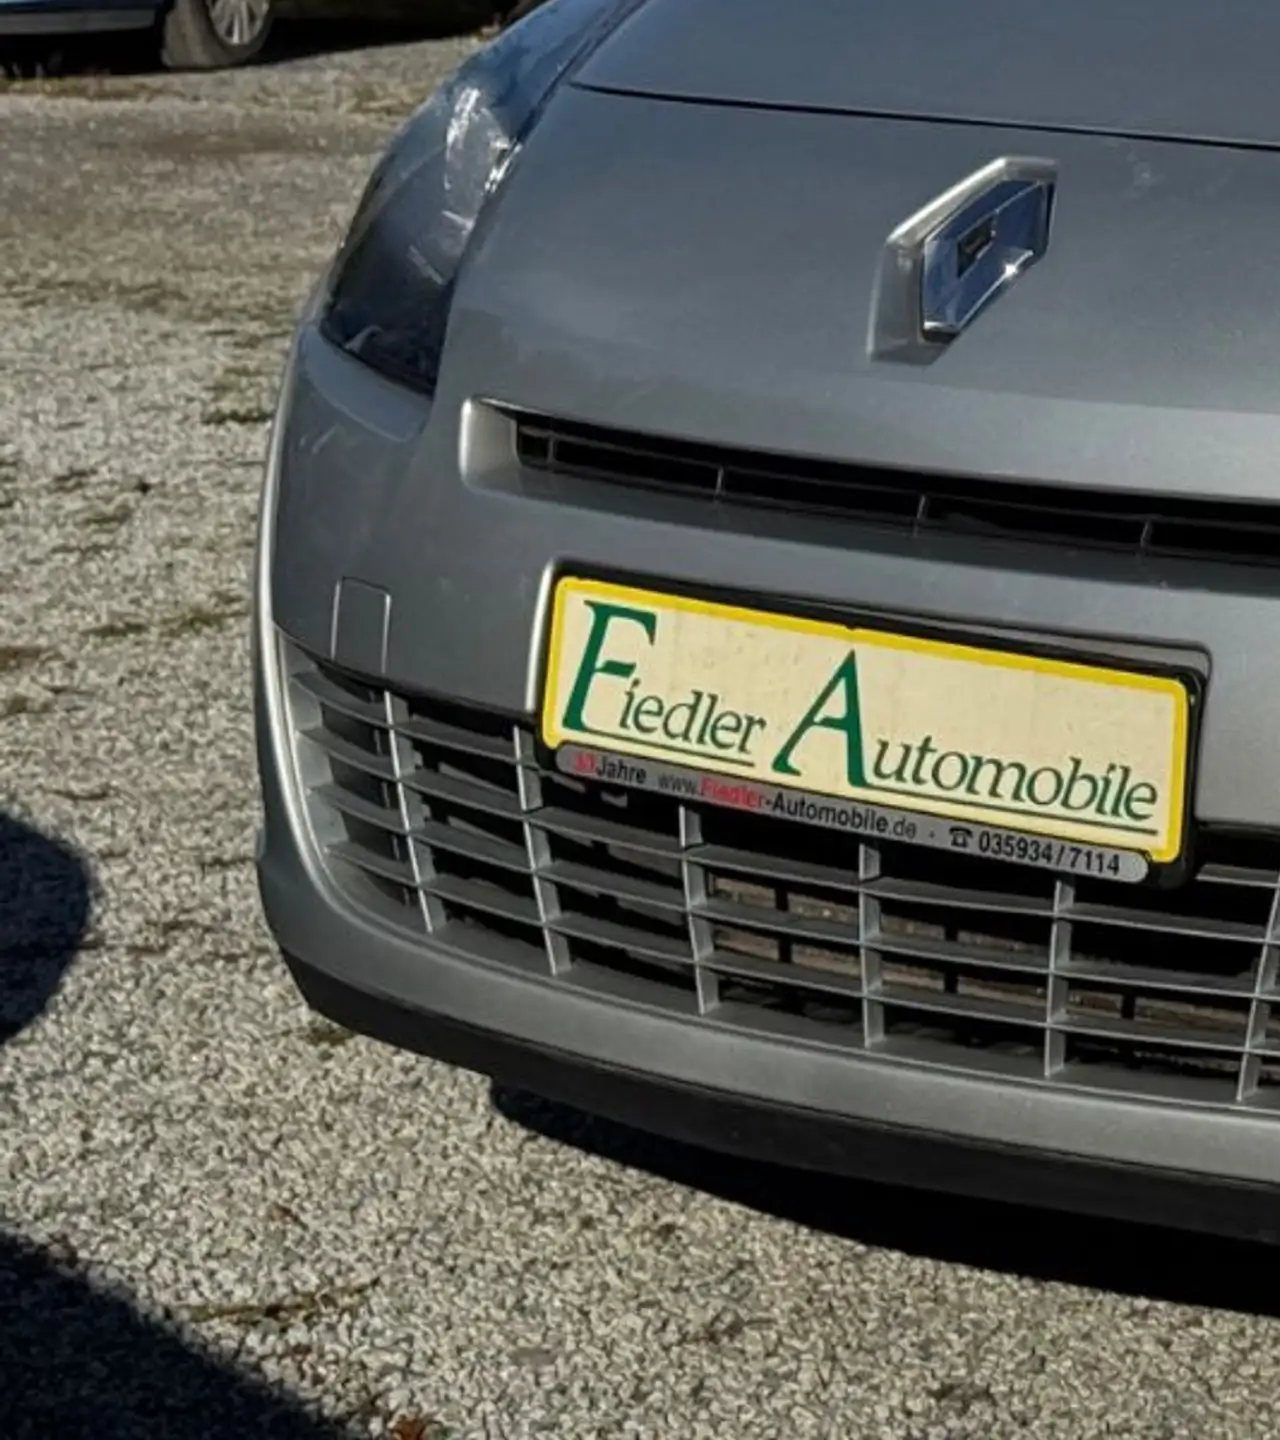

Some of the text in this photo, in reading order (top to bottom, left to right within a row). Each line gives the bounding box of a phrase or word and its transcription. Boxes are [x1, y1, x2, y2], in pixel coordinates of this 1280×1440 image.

[562, 600, 1159, 821] Fiedler Automobile
[596, 756, 647, 784] Jahre
[978, 831, 1120, 875] 035934/7114
